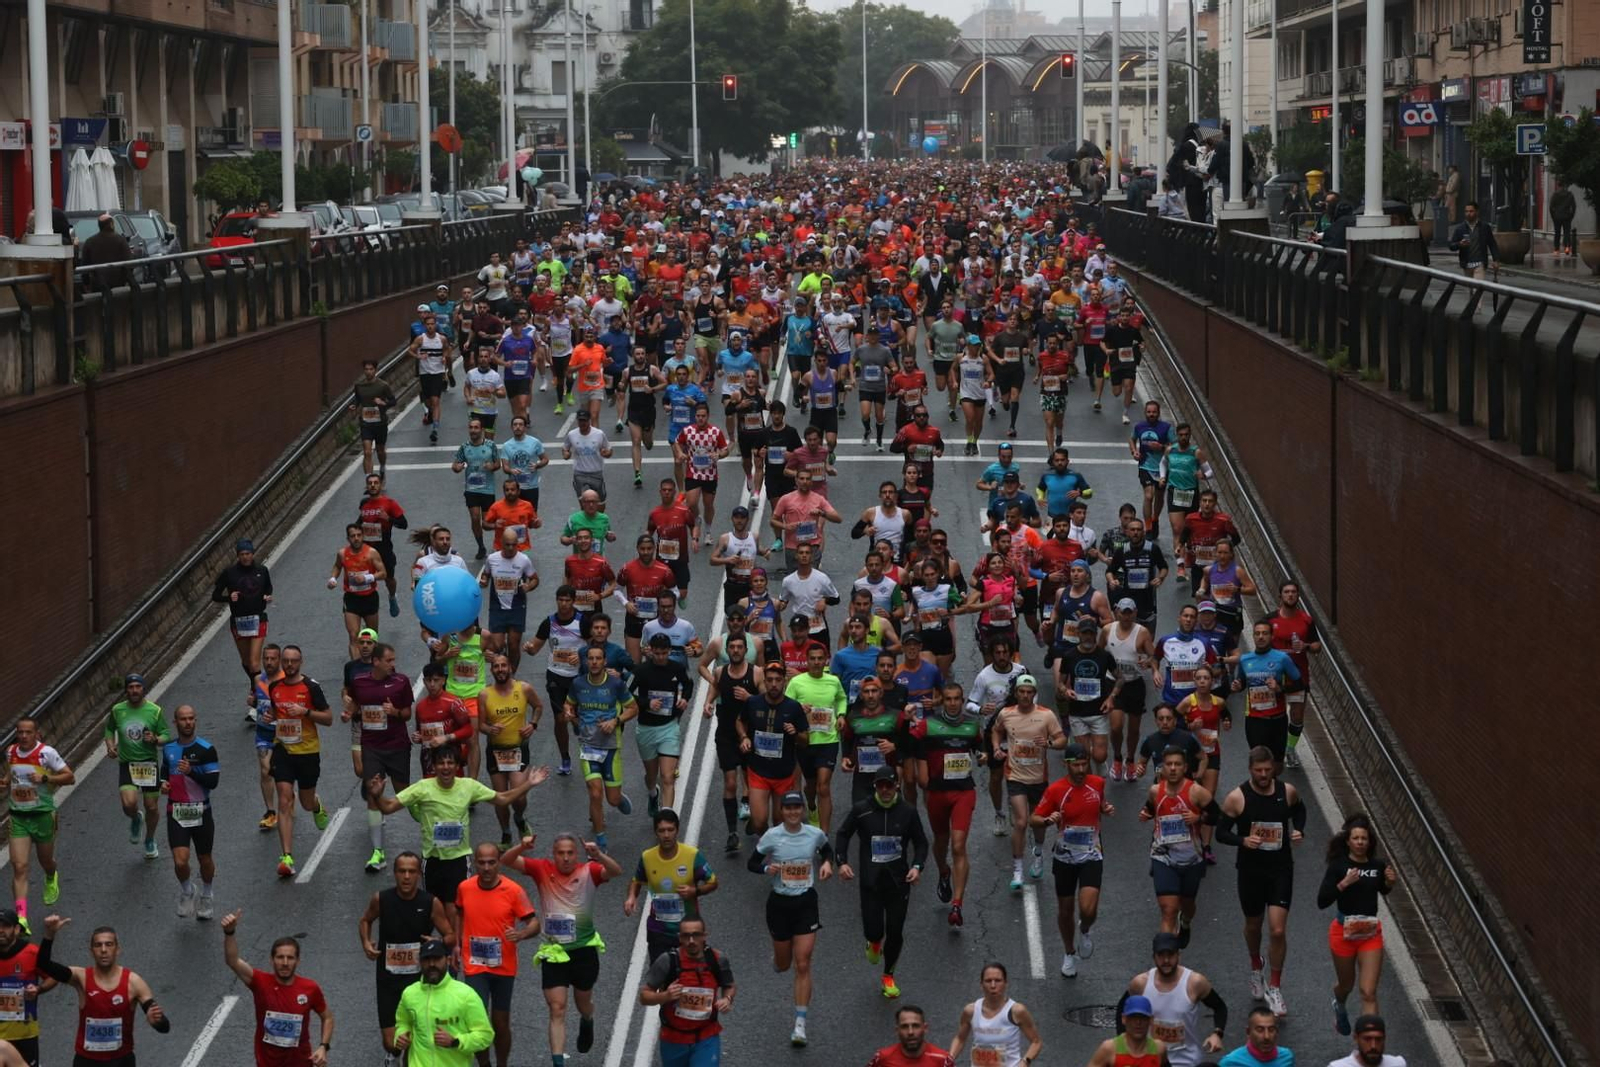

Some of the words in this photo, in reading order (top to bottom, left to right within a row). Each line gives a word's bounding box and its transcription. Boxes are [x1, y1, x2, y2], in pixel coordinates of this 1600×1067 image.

[1530, 0, 1545, 43] OFT
[420, 580, 436, 616] HOKA
[495, 706, 519, 716] teika
[947, 758, 969, 769] 12527
[786, 867, 807, 877] 6289
[1347, 869, 1378, 878] KE
[391, 951, 413, 961] 4578
[90, 1025, 114, 1038] 2438
[269, 1020, 294, 1033] 2229
